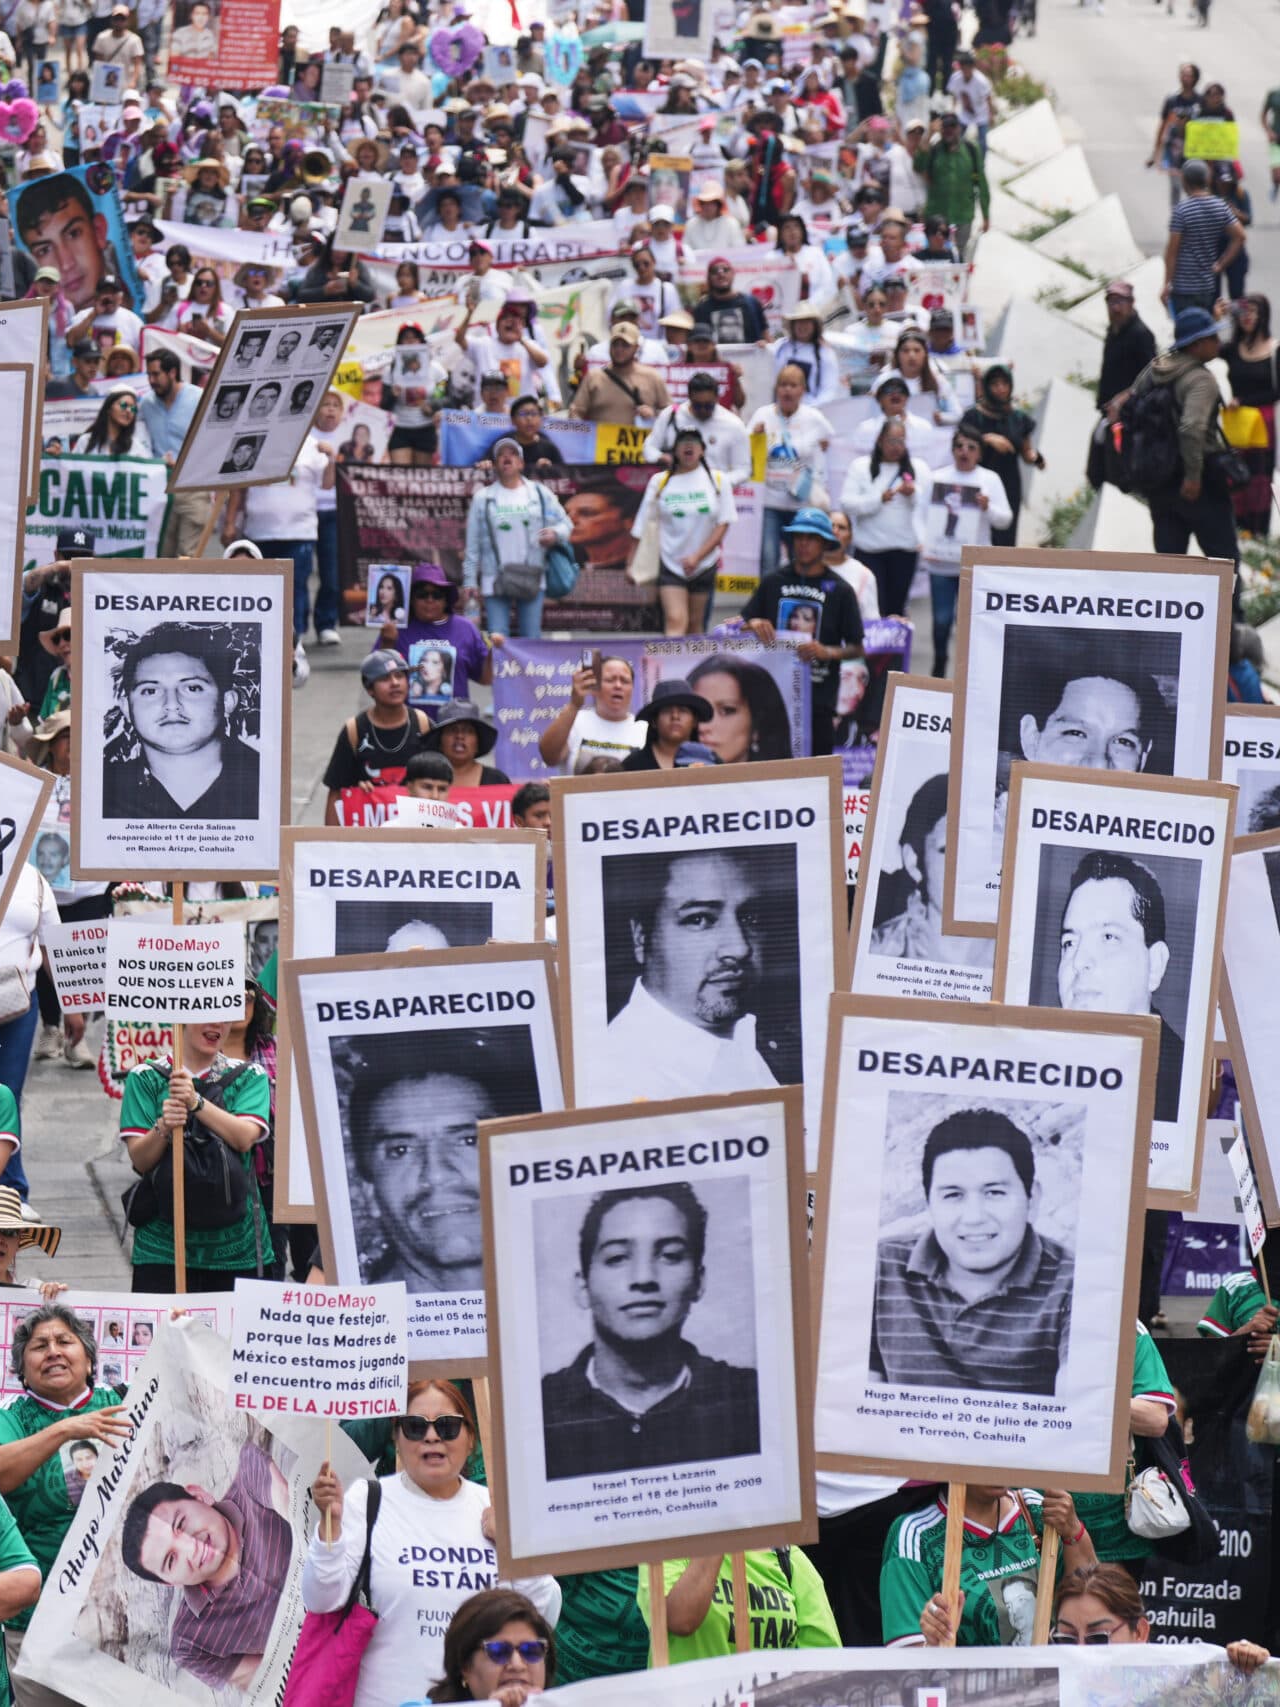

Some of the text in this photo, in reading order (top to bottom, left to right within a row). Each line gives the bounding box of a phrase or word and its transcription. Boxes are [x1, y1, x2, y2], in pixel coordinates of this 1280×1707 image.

[781, 584, 826, 602] SANDRA
[94, 594, 273, 612] DESAPARECIDO
[985, 592, 1205, 621] DESAPARECIDO
[146, 823, 177, 831] Alberto
[179, 823, 204, 831] Cerda
[206, 823, 236, 831] Salinas
[581, 807, 816, 843] DESAPARECIDO
[1031, 808, 1216, 847] DESAPARECIDO
[106, 834, 162, 843] desaparecido
[198, 835, 219, 843] junio
[198, 845, 235, 853] Coahuila
[310, 869, 521, 889] DESAPARECIDA
[53, 945, 95, 959] El único
[138, 938, 220, 954] #10DeMayo
[57, 962, 99, 975] importa
[118, 958, 235, 972] NOS URGEN GOLES
[896, 962, 923, 973] Claudia
[58, 977, 103, 989] nuestros
[118, 976, 235, 989] QUE NOS LLEVEN A
[876, 972, 923, 986] desaparecida
[108, 994, 242, 1010] ENCONTRARLOS
[940, 993, 971, 1001] Coahuila
[317, 990, 536, 1023] DESAPARECIDO
[858, 1049, 1123, 1091] DESAPARECIDO
[509, 1136, 770, 1187] DESAPARECIDO
[282, 1290, 376, 1311] #10DeMayo
[415, 1297, 483, 1308] Santana Cruz
[260, 1308, 302, 1323] Nada
[306, 1313, 335, 1327] que
[446, 1312, 474, 1321] 05 de
[247, 1331, 397, 1347] porque las Madres de
[415, 1326, 486, 1338] Gómez Palaci
[233, 1349, 405, 1372] México estamos jugando
[234, 1372, 365, 1391] el encuentro más
[235, 1394, 401, 1416] EL DE LA JUSTICIA.
[865, 1389, 1067, 1414] Hugo Marcelino González Salazar
[857, 1405, 1072, 1430] desaparecido el 20 de julio de 2009
[899, 1426, 1026, 1443] en Torreón, Coahuila
[58, 1376, 160, 1595] Hugo Marcelino
[592, 1475, 668, 1491] Israel Torres
[548, 1477, 763, 1513] desaparecido el 18 de junio de 2009
[594, 1513, 609, 1522] en
[666, 1499, 718, 1513] Coahuila
[398, 1546, 496, 1565] ¿DONDE
[977, 1557, 1037, 1581] DESAPARECID
[1163, 1577, 1242, 1600] Forzada
